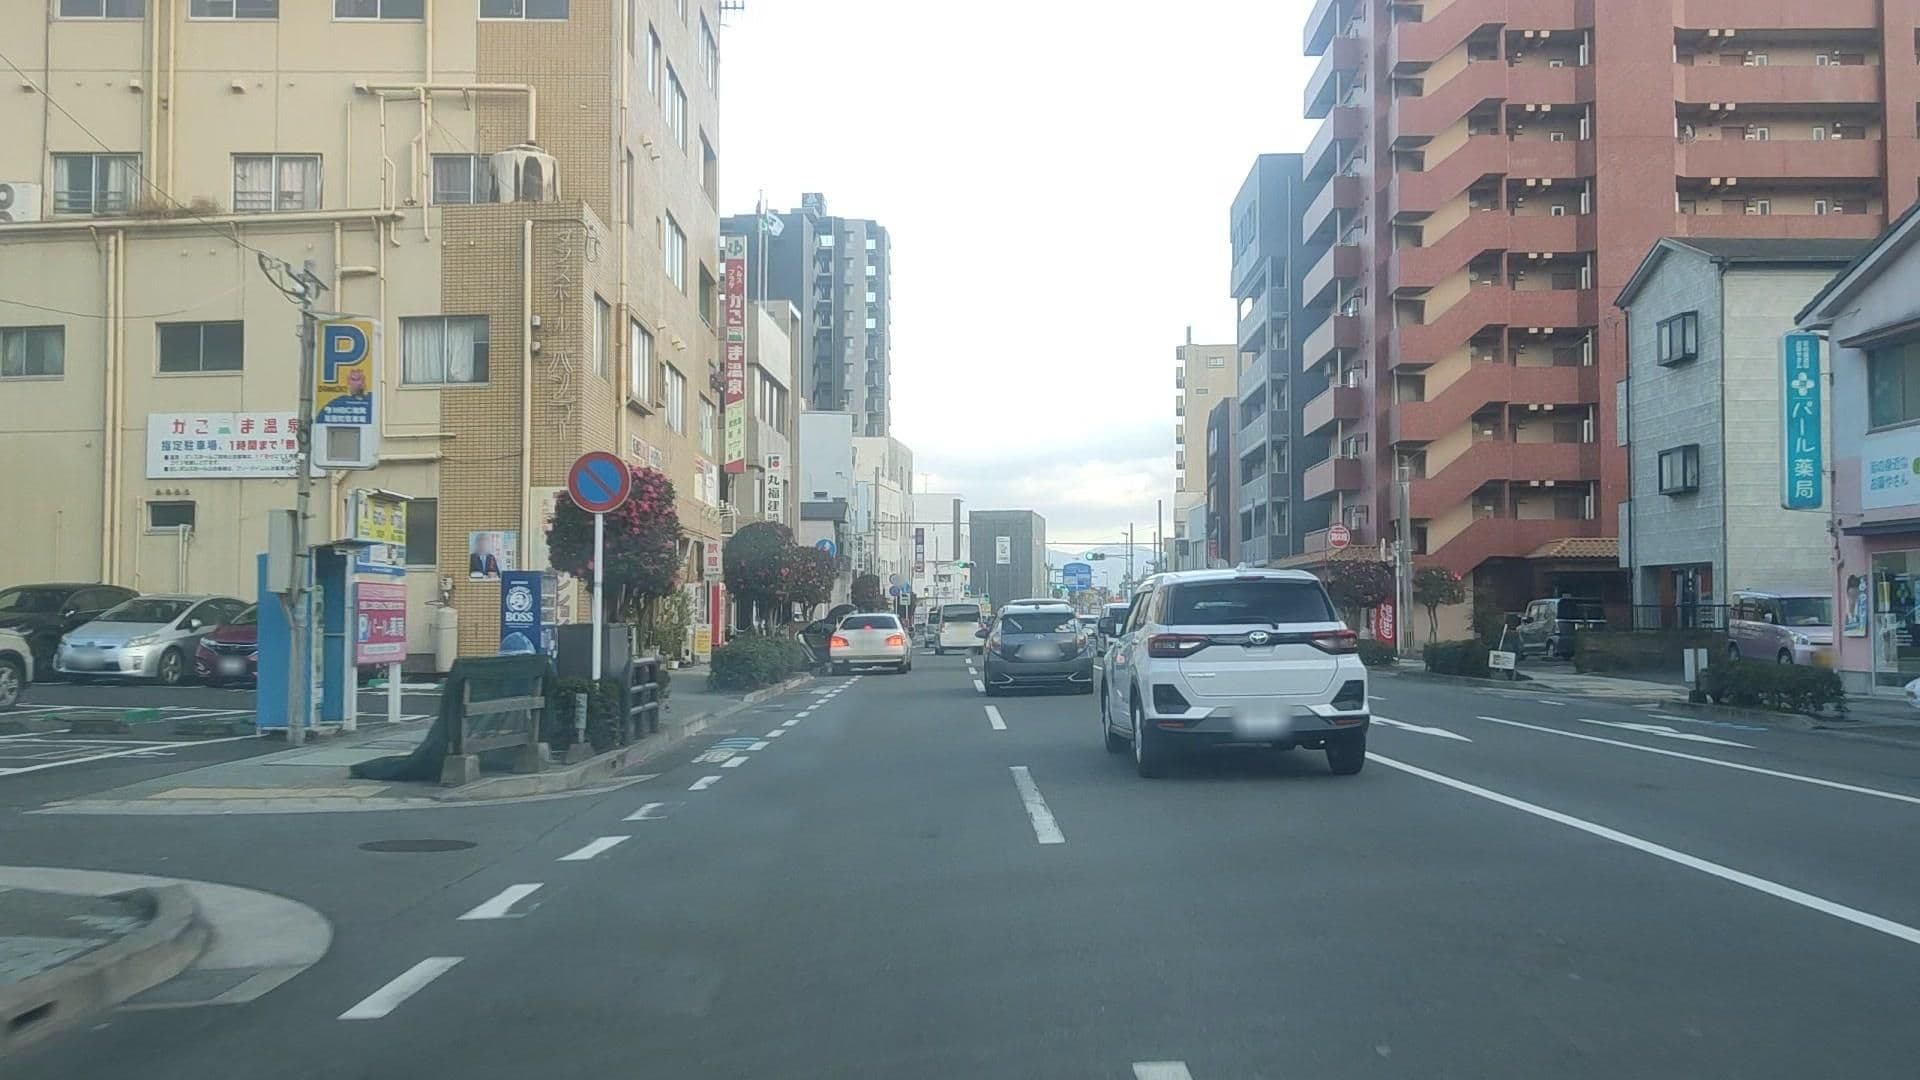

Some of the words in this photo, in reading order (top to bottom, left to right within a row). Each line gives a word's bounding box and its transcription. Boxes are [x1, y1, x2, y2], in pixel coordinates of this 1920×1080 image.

[322, 324, 369, 383] P
[1792, 400, 1816, 499] パール薬局
[505, 612, 534, 622] BOSS
